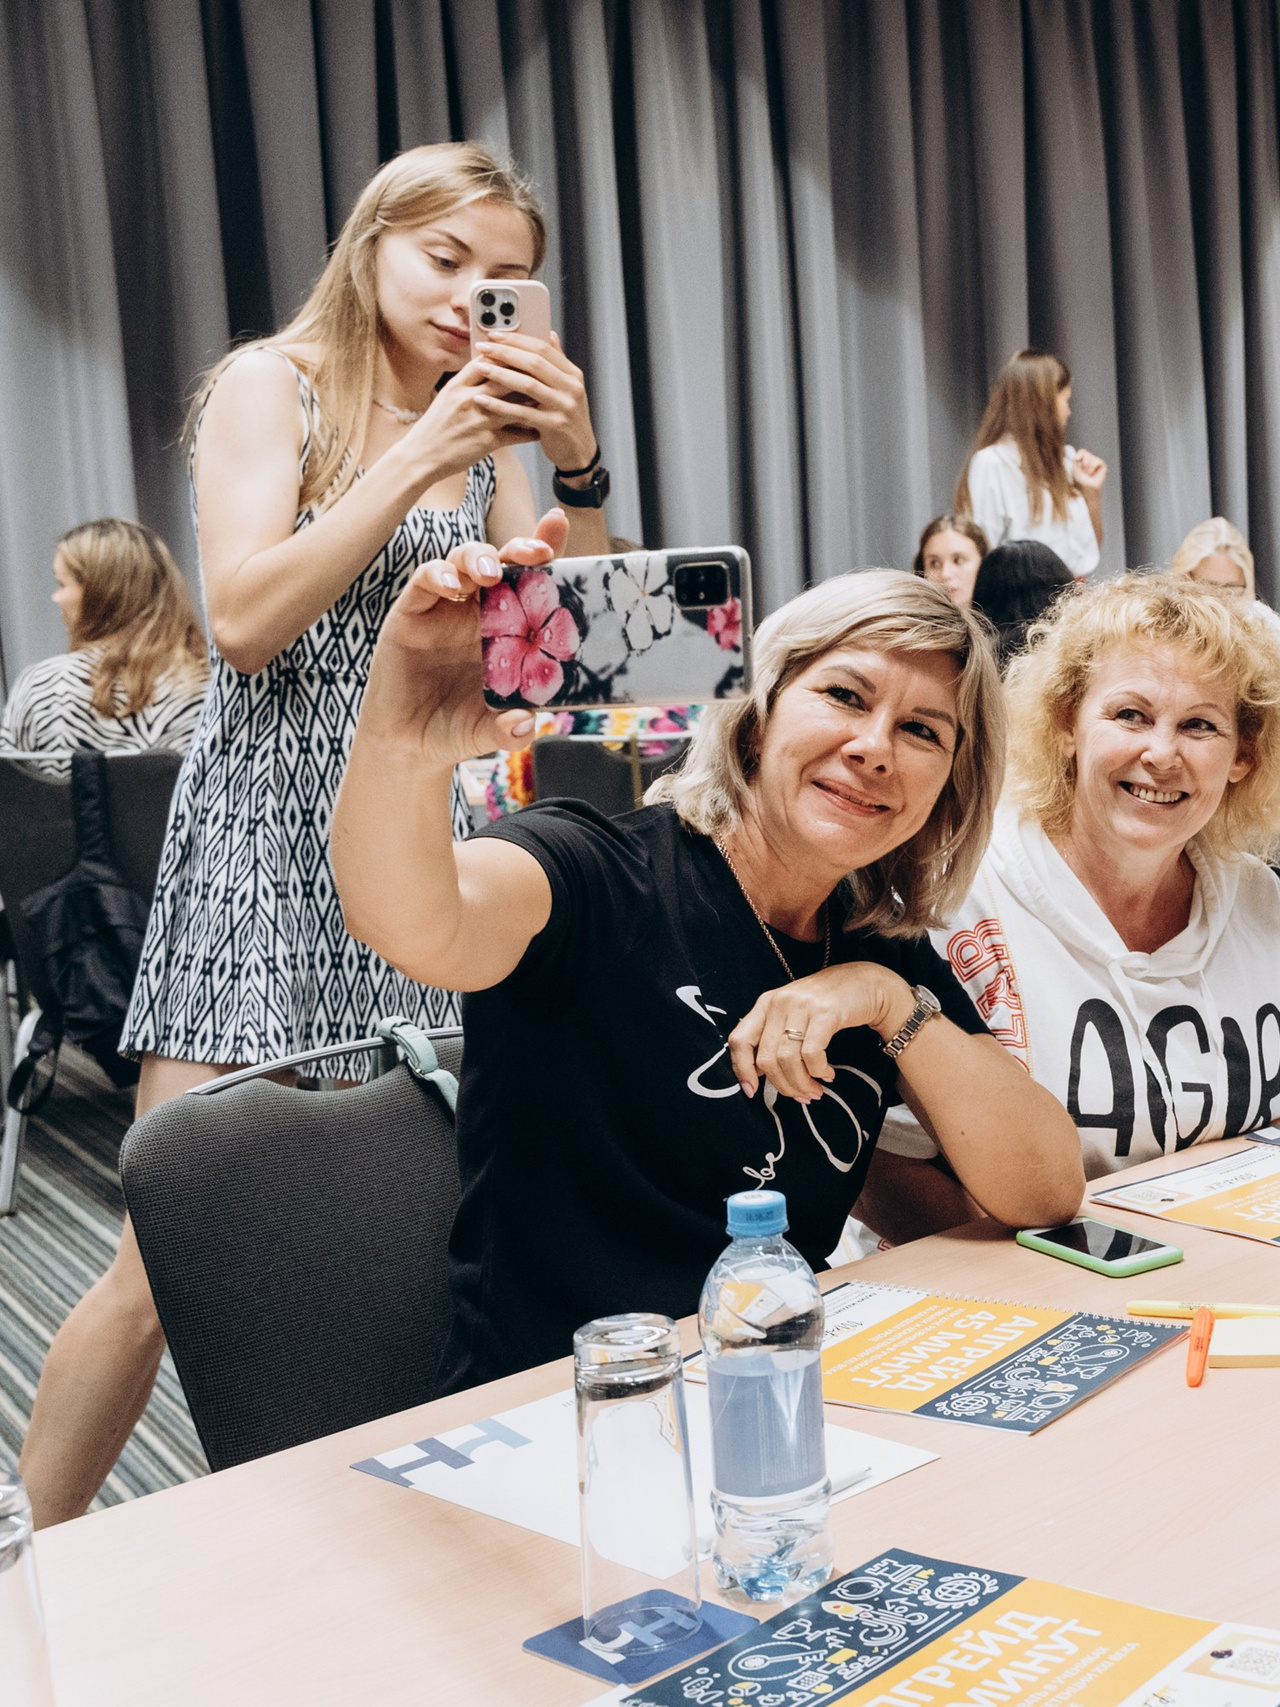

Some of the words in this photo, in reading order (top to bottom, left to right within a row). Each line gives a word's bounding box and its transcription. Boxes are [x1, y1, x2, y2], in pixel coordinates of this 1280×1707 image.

[882, 1315, 1039, 1391] АПГРЕЙД
[953, 1310, 997, 1330] 45
[852, 1331, 967, 1388] МИНУТ
[860, 1610, 1063, 1707] ПГРЕЙД
